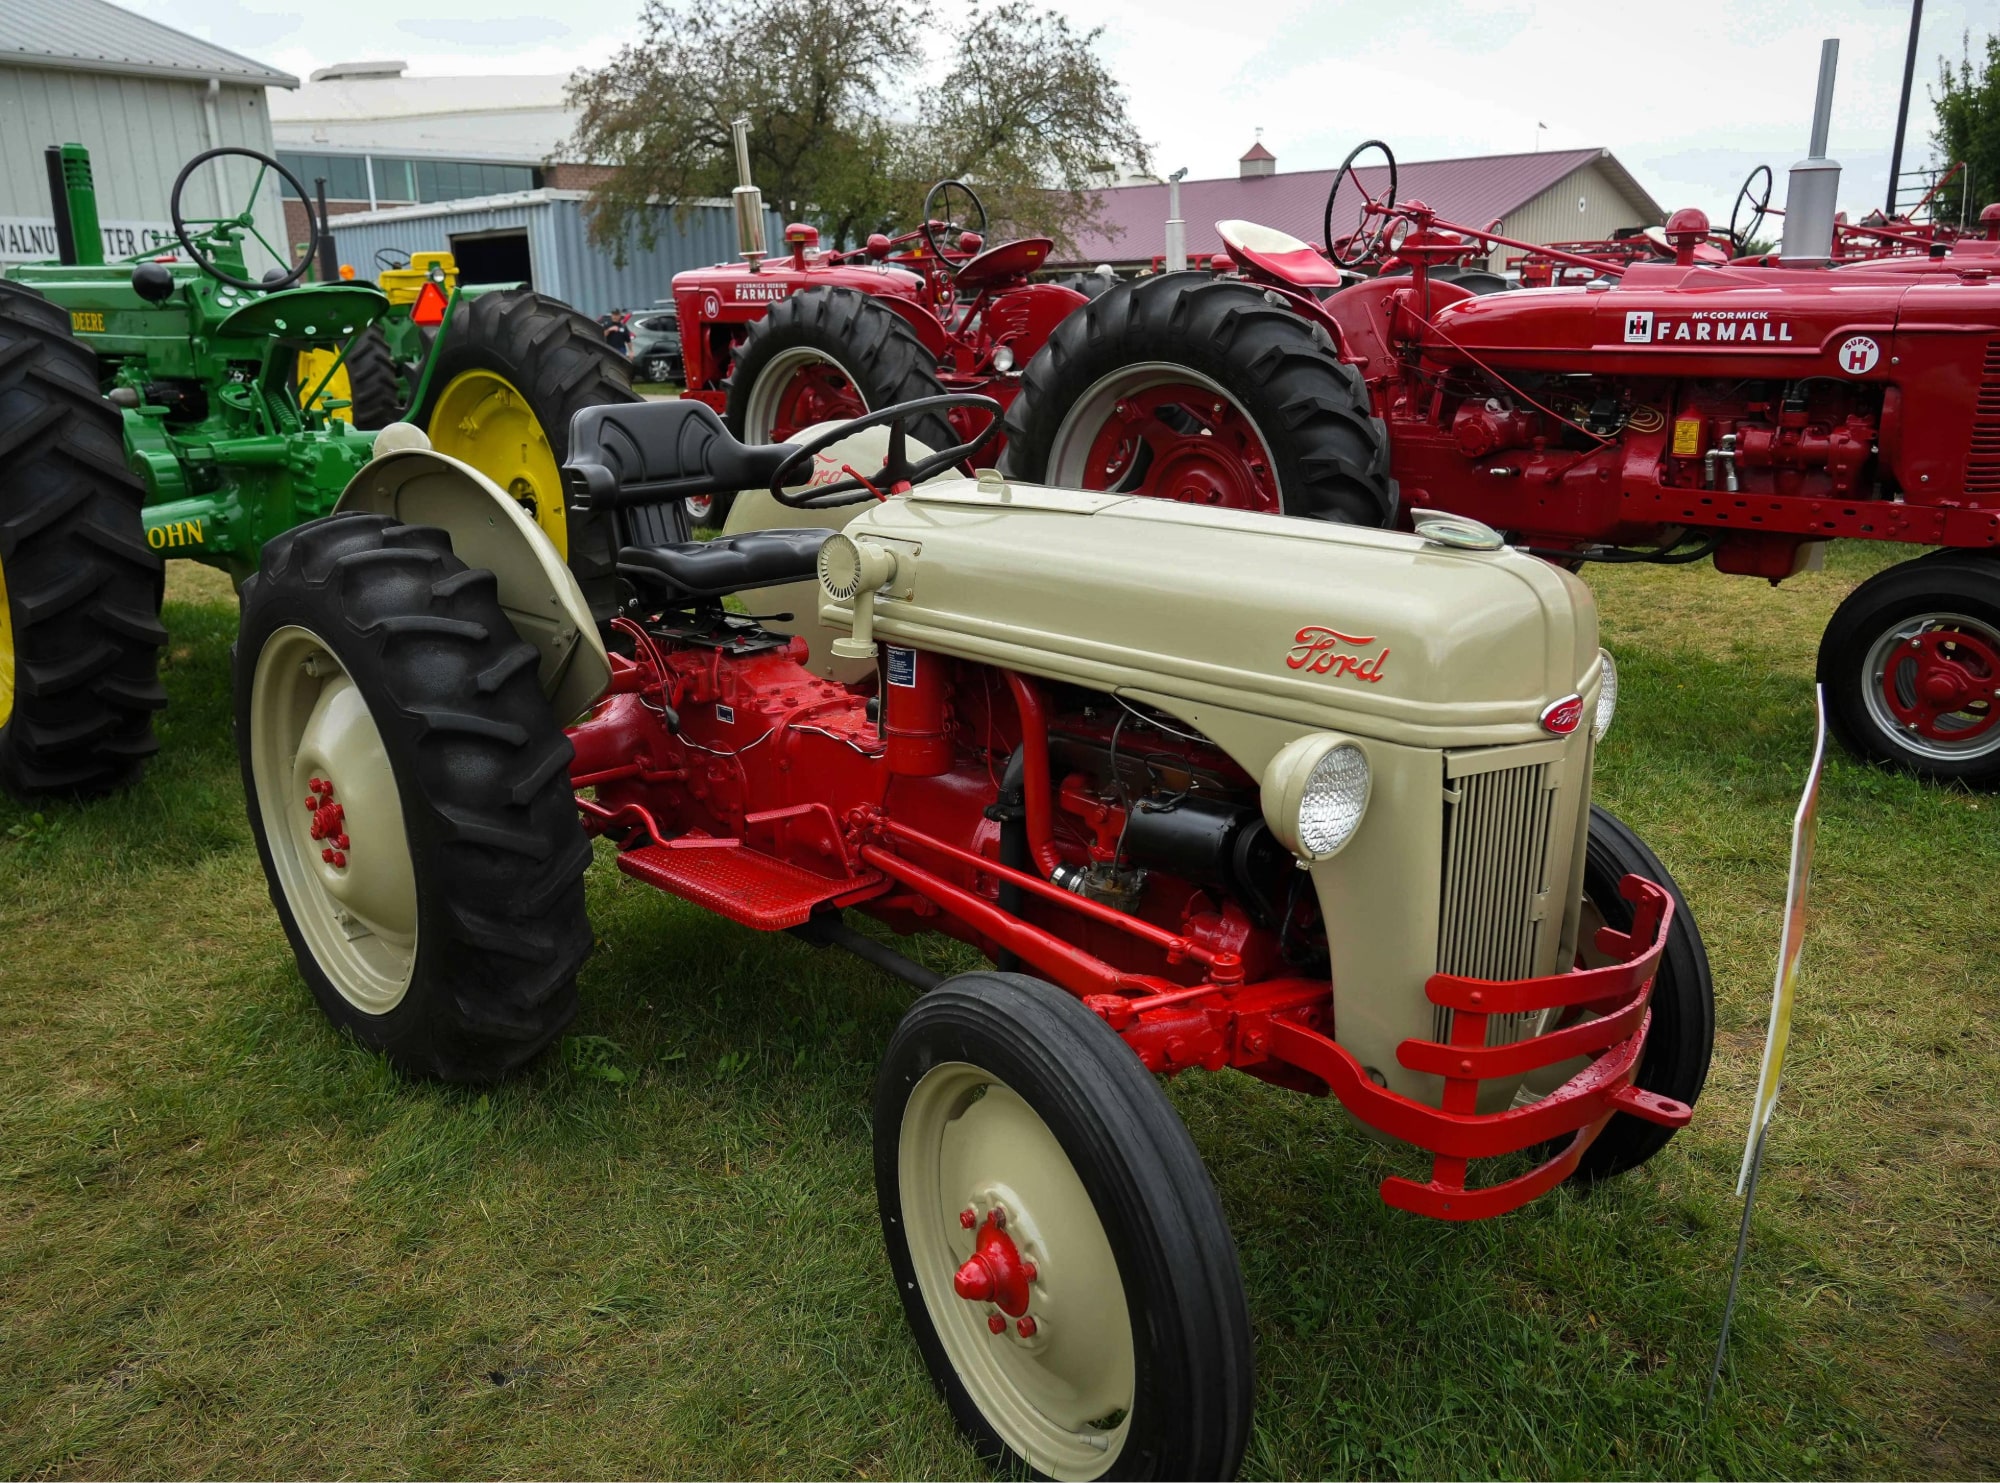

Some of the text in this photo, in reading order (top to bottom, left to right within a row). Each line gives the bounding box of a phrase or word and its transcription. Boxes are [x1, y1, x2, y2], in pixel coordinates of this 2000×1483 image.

[707, 301, 716, 314] M
[1692, 312, 1769, 320] McCORMICK
[72, 312, 105, 332] DEERE
[1657, 322, 1793, 341] FARMALL
[1844, 338, 1875, 351] SUPER
[1848, 350, 1868, 371] H
[147, 519, 204, 549] OHN
[1286, 625, 1390, 683] Ford
